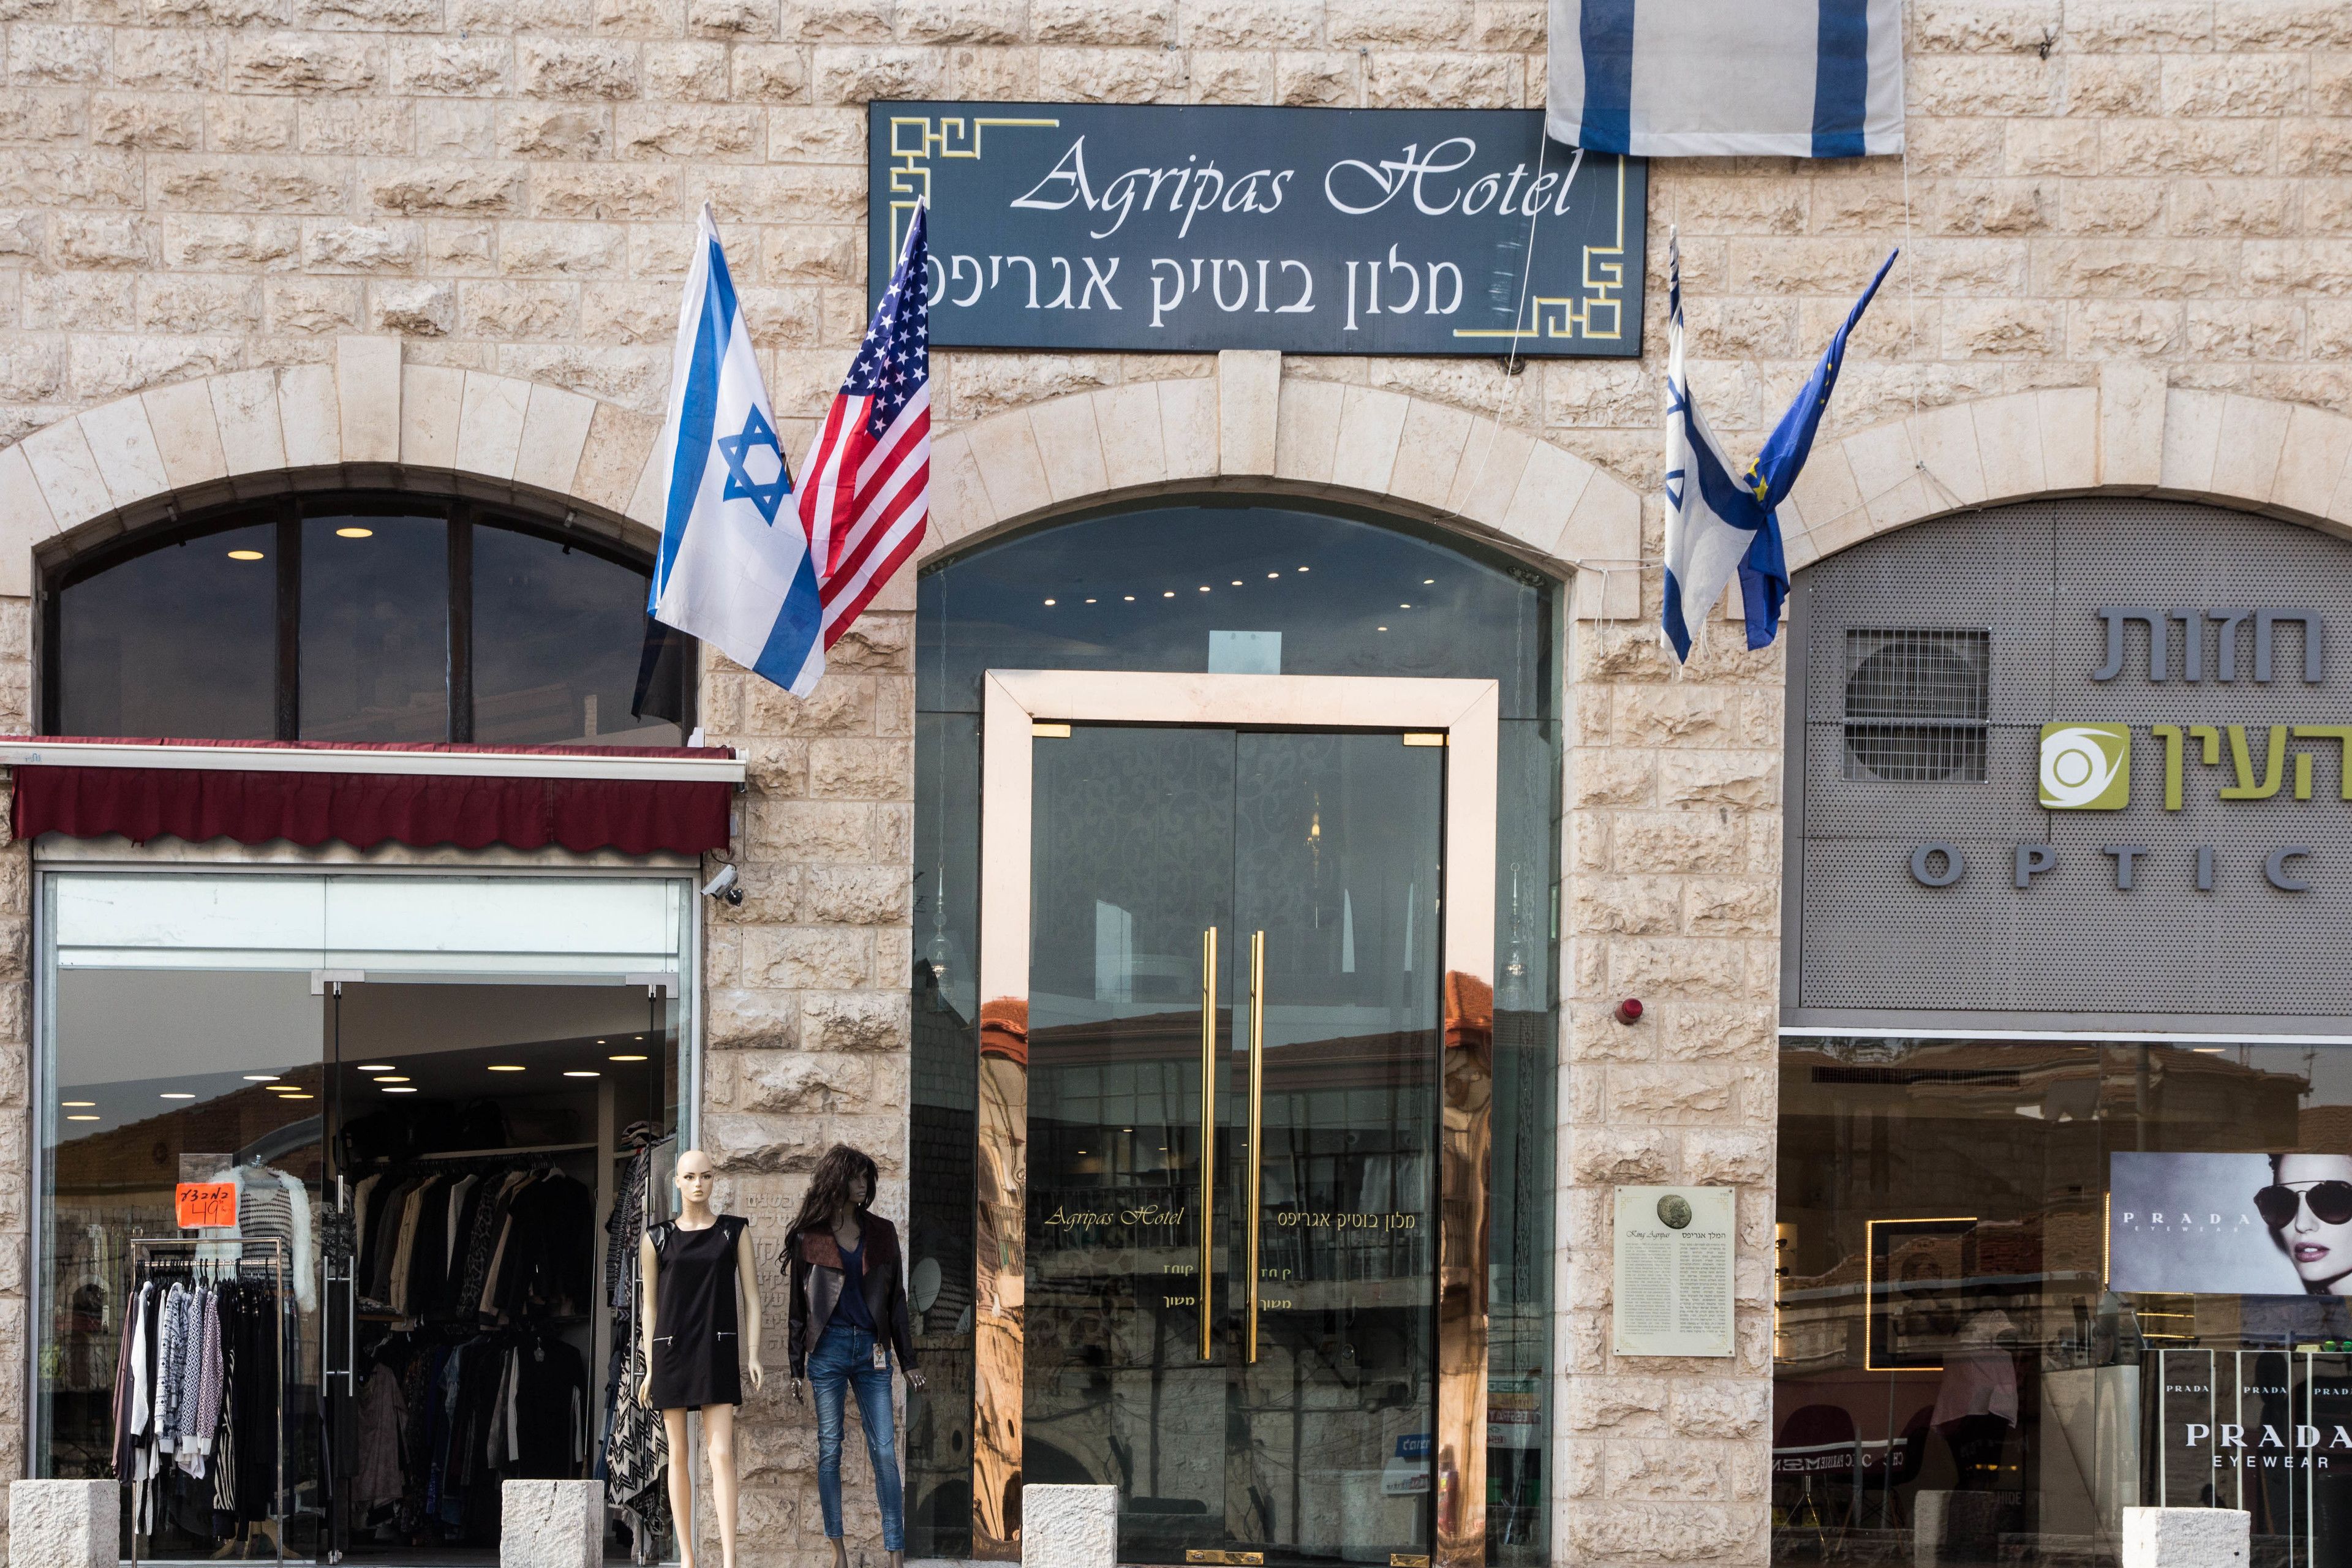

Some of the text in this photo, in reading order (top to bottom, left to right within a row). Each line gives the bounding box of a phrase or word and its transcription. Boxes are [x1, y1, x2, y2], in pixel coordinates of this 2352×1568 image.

[1009, 134, 1585, 239] Agripas Hotel
[1148, 258, 1316, 328] בוטיק
[1342, 243, 1464, 331] מלון
[2092, 606, 2323, 683] חזות
[2152, 725, 2352, 811] העין
[1910, 840, 2311, 891] OPTIC
[1044, 1204, 1185, 1231] Agripas Hotel
[1278, 1211, 1415, 1232] מלון בוטיק אגריפס
[2123, 1212, 2250, 1224] PRADA
[1626, 1231, 1670, 1240] King Agripas
[1708, 1232, 1726, 1240] המלך
[1163, 1296, 1195, 1308] משוך
[1260, 1299, 1292, 1311] משוך
[2185, 1423, 2352, 1449] PRADA
[2213, 1455, 2328, 1468] EYEWEAR
